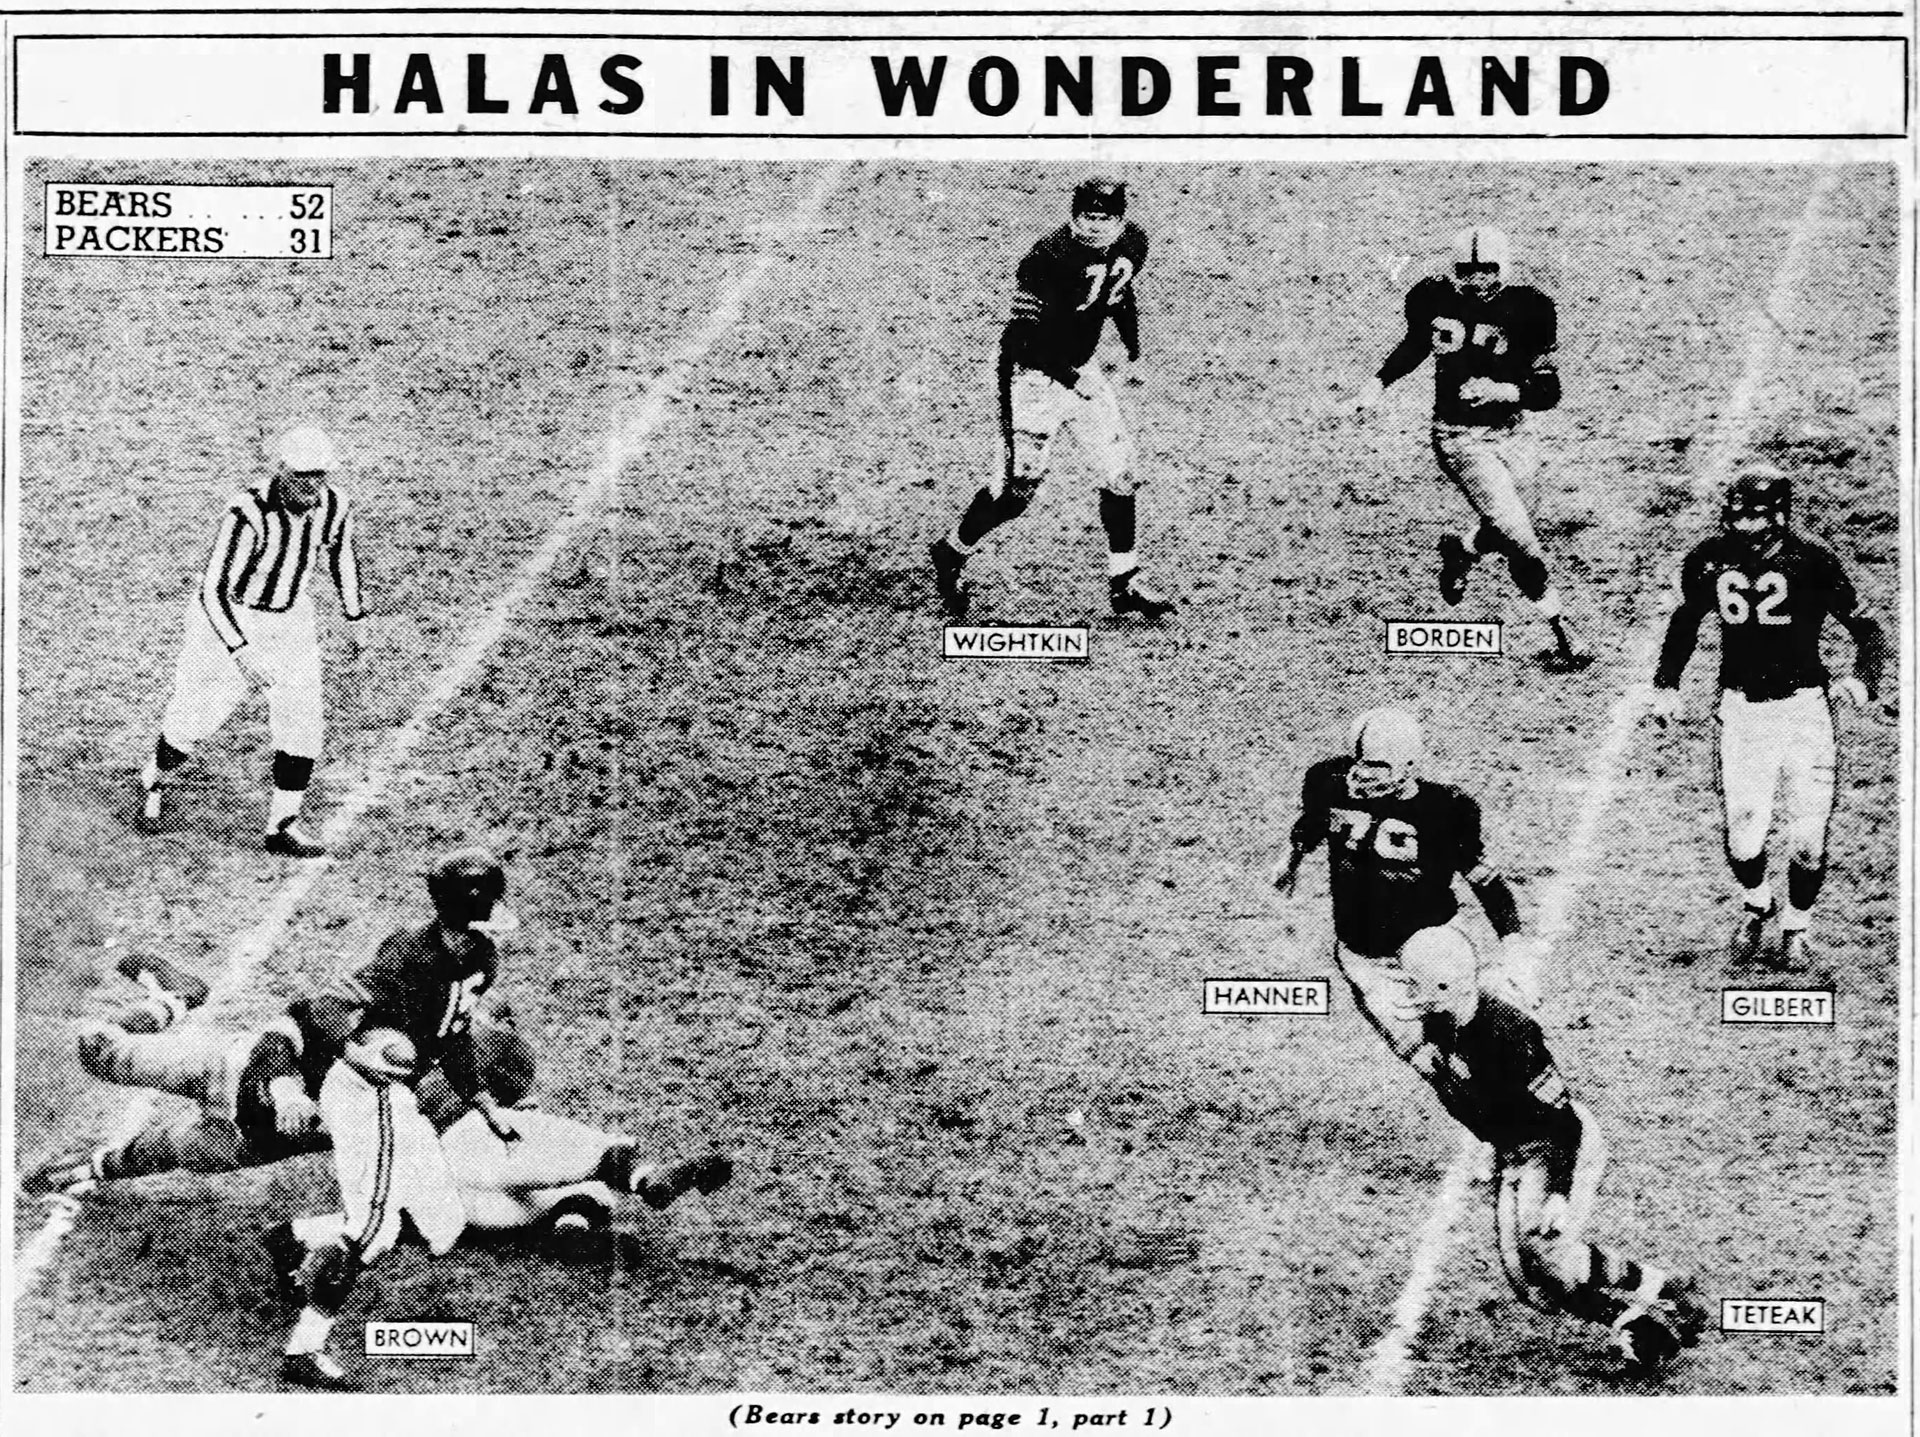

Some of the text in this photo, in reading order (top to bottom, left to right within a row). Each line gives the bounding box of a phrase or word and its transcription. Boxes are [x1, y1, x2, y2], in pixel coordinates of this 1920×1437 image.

[323, 53, 1611, 118] HALAS IN WONDERLAND
[1076, 256, 1134, 312] 72
[1716, 569, 1792, 625] 62
[729, 1404, 1172, 1431] (Bears story on page 1, part 1)
